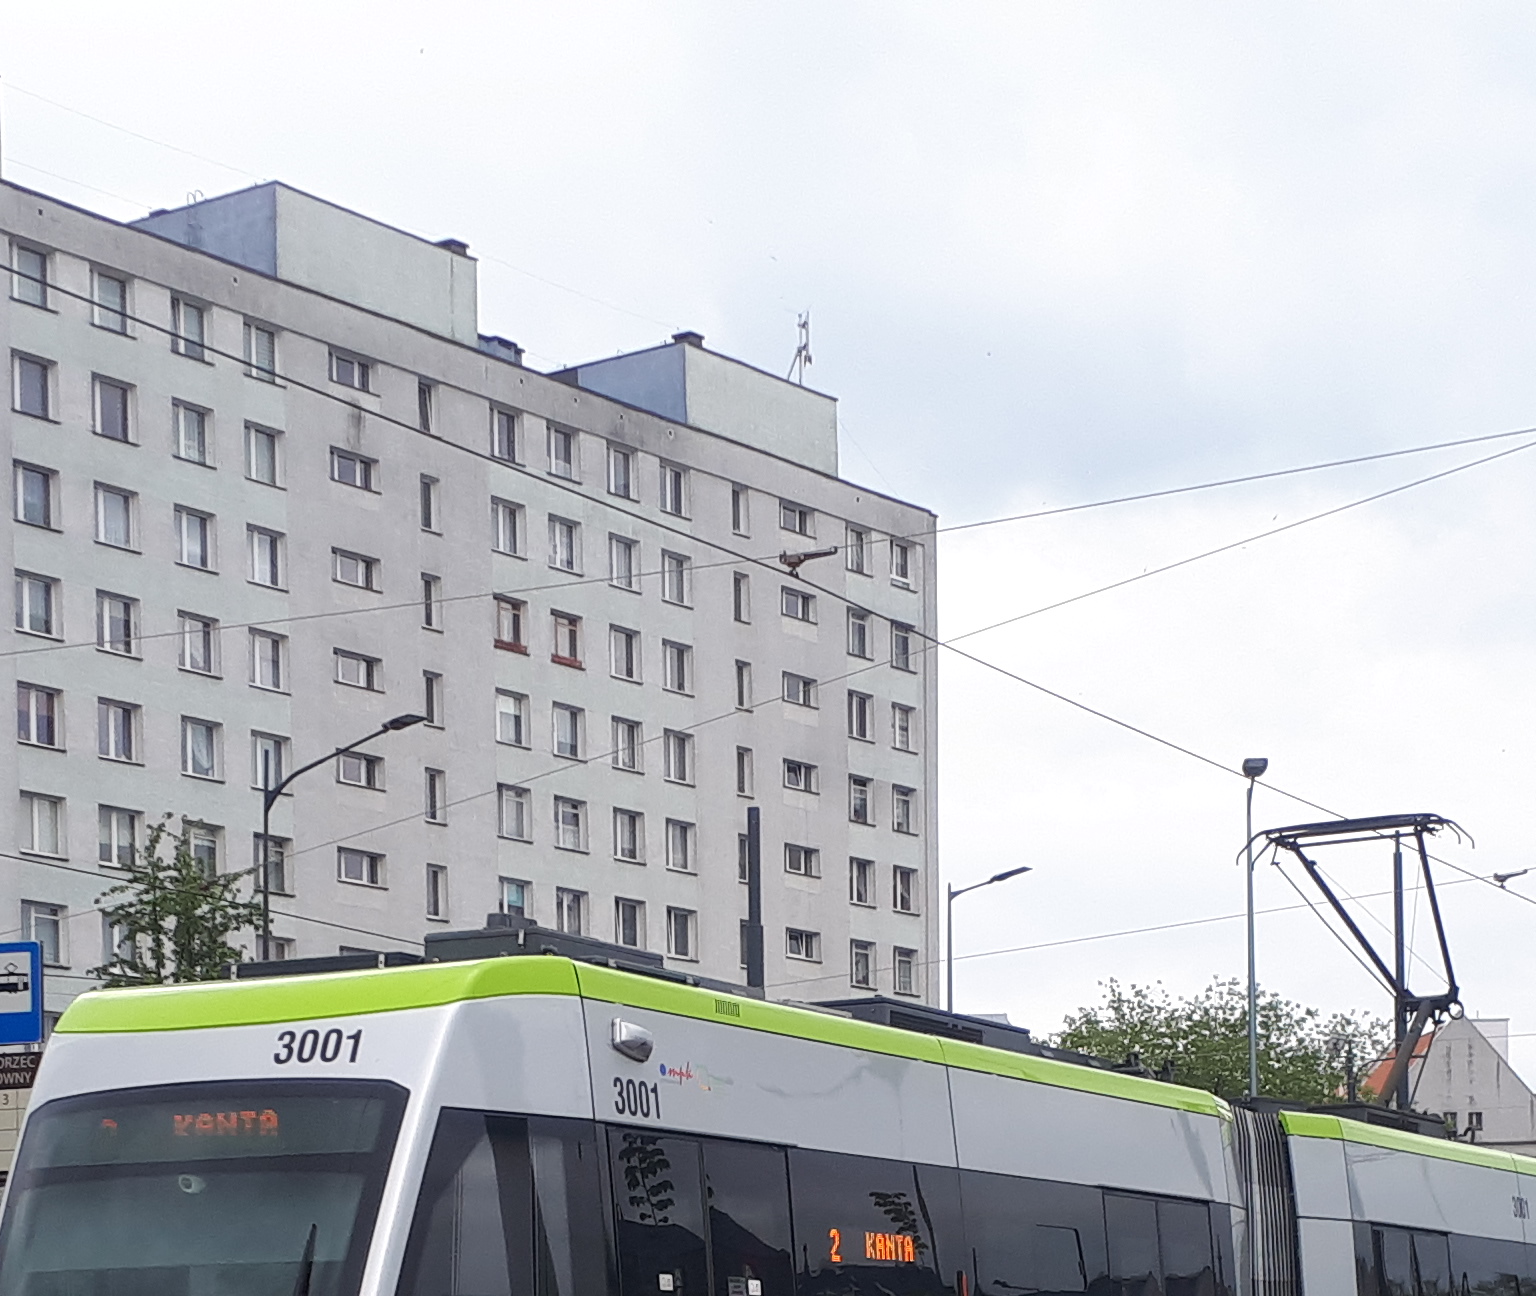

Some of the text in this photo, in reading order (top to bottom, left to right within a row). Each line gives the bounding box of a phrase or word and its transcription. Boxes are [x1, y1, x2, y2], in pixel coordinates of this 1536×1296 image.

[273, 1028, 363, 1065] 3001
[2, 1093, 10, 1105] 3
[613, 1077, 661, 1119] 3001
[829, 1228, 915, 1262] 2 KANTA
